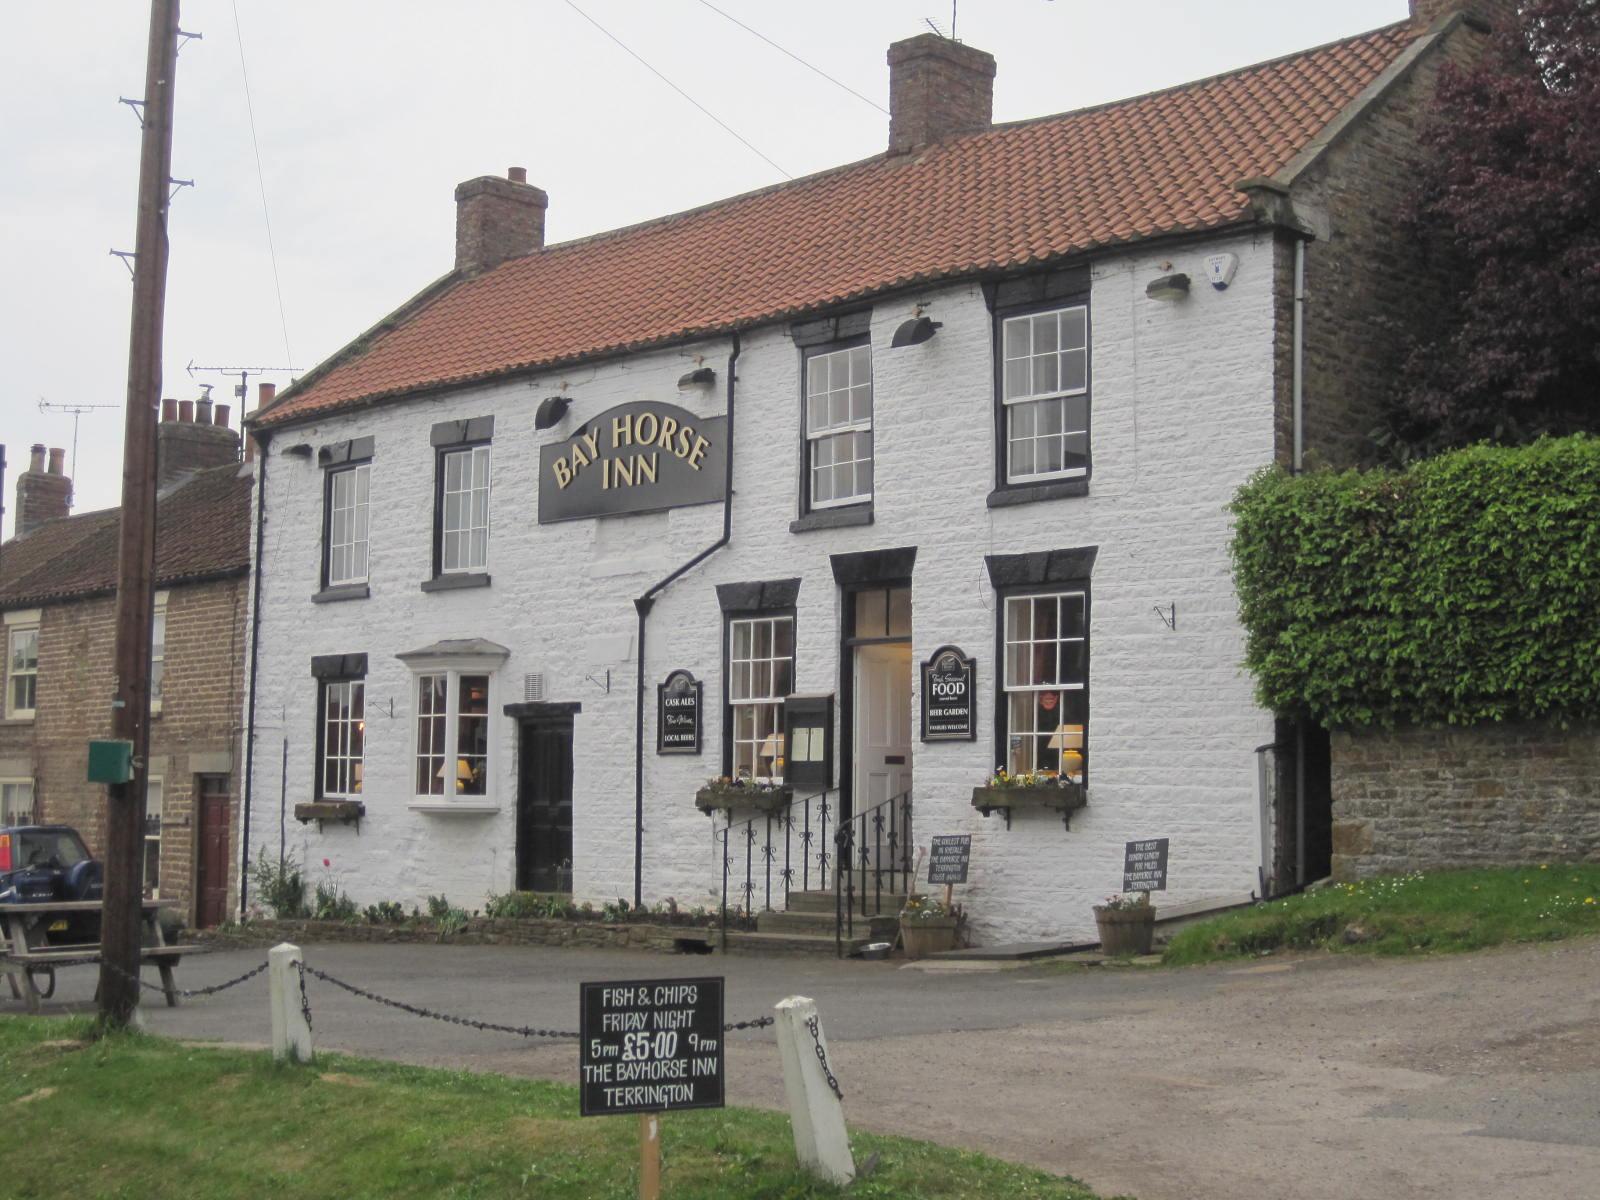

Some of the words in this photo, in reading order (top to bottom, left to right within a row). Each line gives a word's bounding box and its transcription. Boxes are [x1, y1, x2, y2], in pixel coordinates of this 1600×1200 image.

[552, 426, 600, 490] BAY
[612, 412, 711, 471] HORSE
[602, 452, 658, 490] INN
[932, 682, 965, 696] FOOD
[665, 698, 680, 707] CASK
[681, 697, 696, 706] ALES
[929, 708, 943, 717] BEER
[943, 707, 968, 716] GARDEN
[664, 734, 680, 742] LOCAL
[603, 987, 635, 1008] FISH
[637, 987, 651, 1006] &
[654, 985, 698, 1006] CHIPS
[602, 1012, 648, 1032] FRIDAY
[653, 1010, 696, 1030] NIGHT
[583, 1064, 613, 1083] THE
[616, 1059, 688, 1082] BAYHORSE
[692, 1057, 717, 1077] INN
[603, 1083, 694, 1109] TERRINGTON
